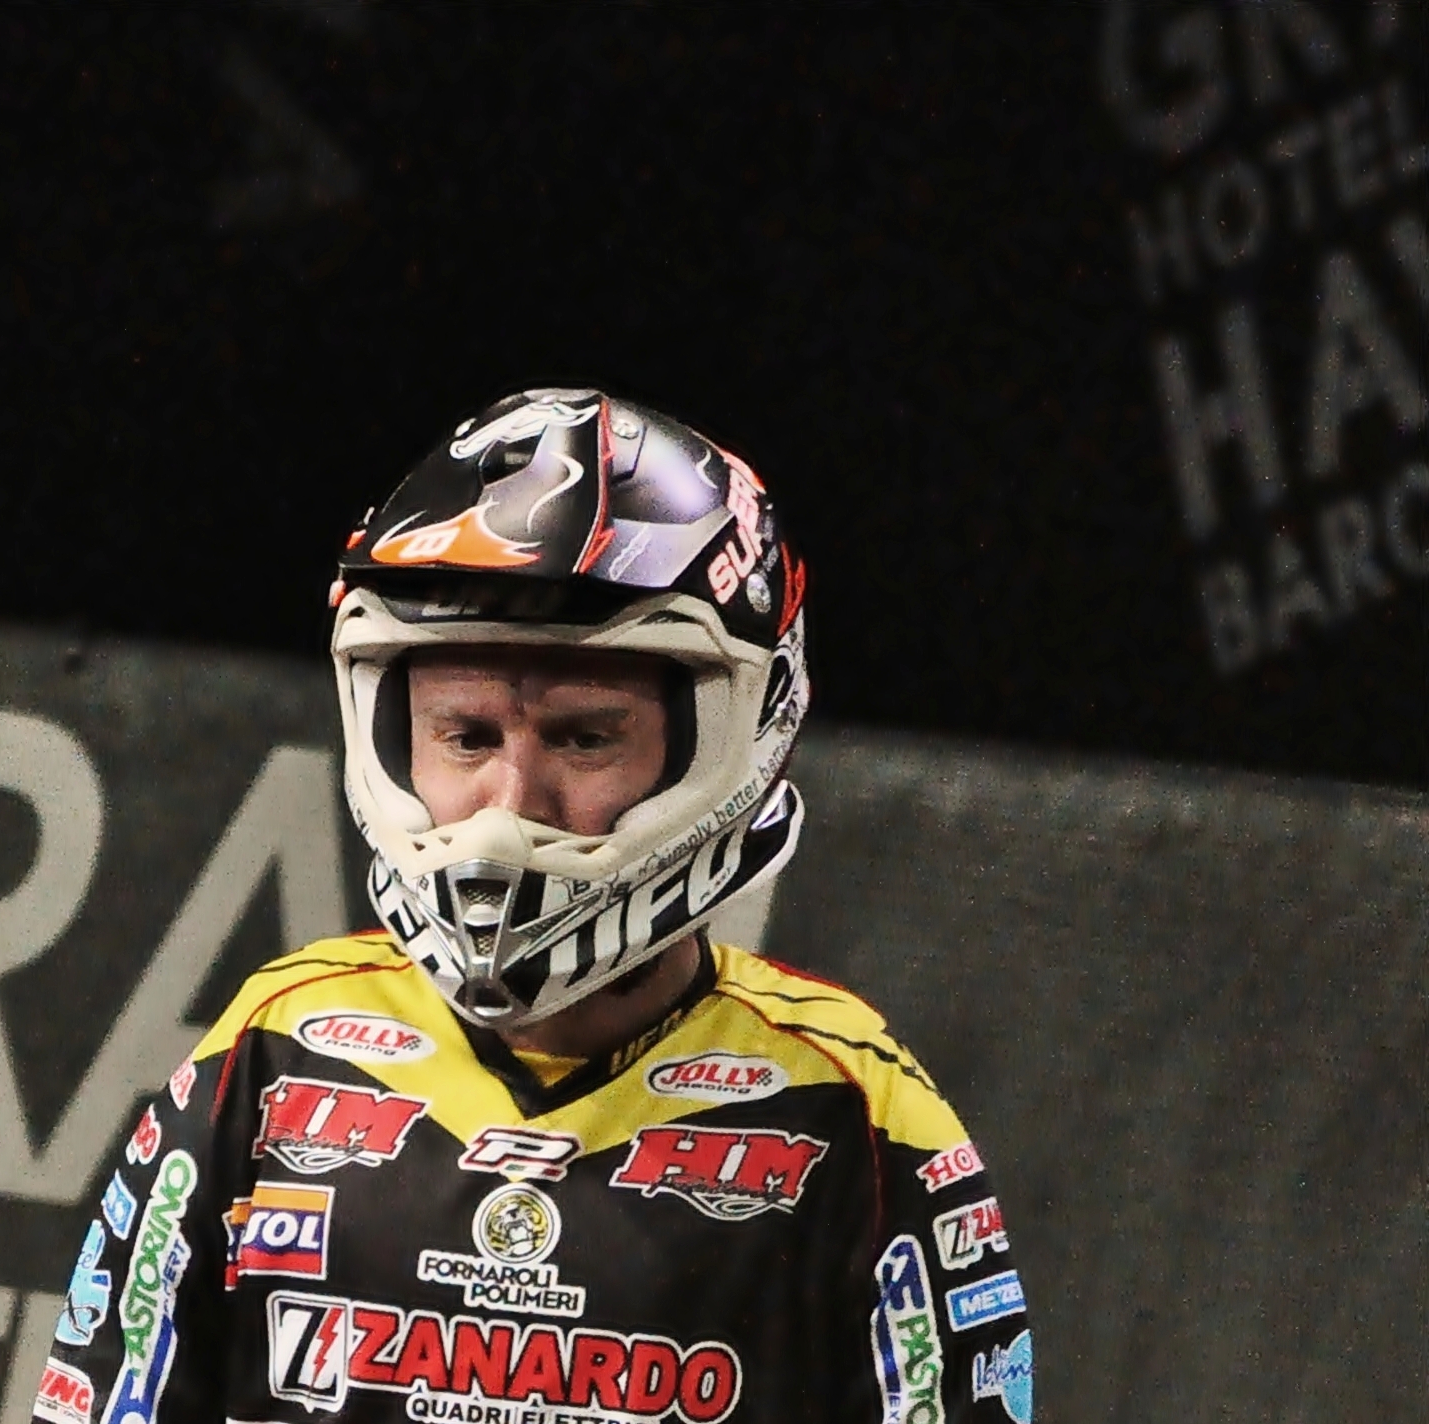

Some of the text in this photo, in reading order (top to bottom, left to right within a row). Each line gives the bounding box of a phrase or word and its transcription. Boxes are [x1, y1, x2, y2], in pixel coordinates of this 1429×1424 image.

[310, 1018, 417, 1048] JOLLY
[659, 1062, 769, 1086] JOLLY
[422, 1256, 552, 1288] FORNAROLI
[469, 1284, 580, 1312] POLIMERI
[348, 1307, 736, 1422] ZANARDO
